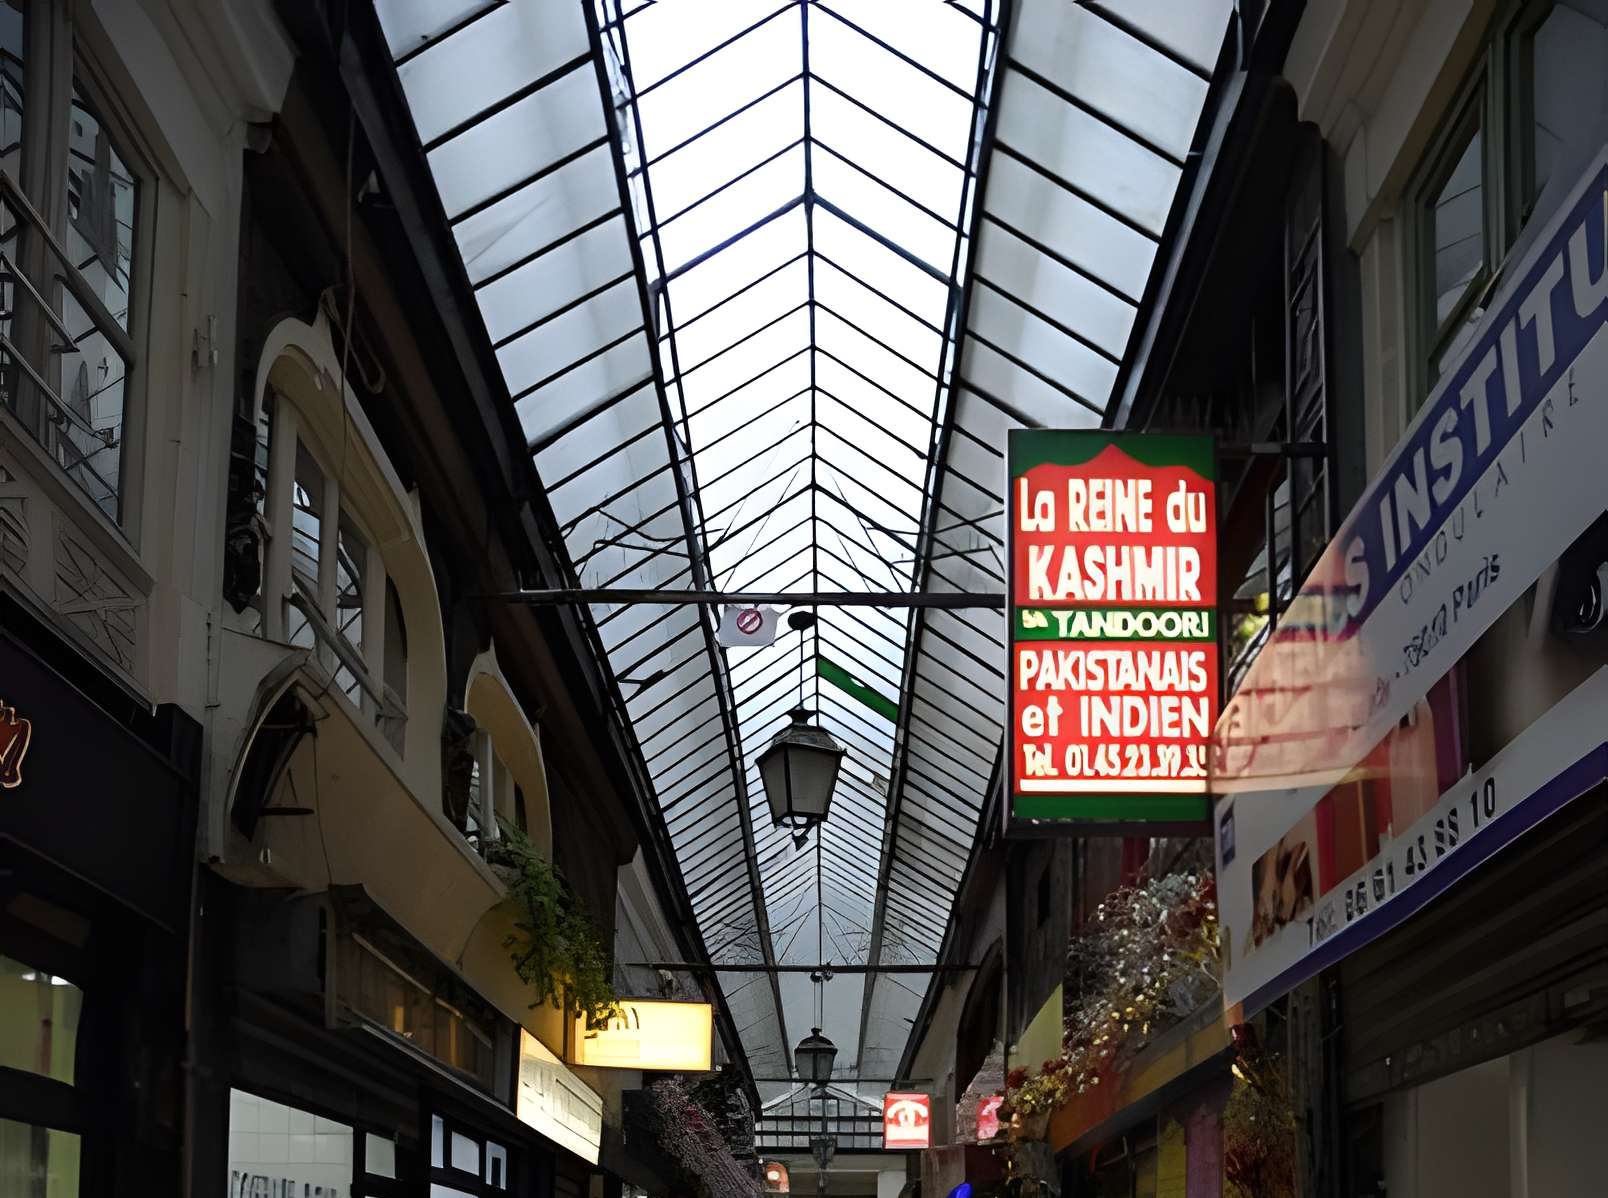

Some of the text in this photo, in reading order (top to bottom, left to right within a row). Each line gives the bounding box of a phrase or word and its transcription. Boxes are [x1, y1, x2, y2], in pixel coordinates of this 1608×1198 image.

[1068, 478, 1152, 533] REINE
[1166, 480, 1207, 533] du
[1028, 544, 1201, 601] KASHMIR
[1051, 610, 1209, 638] TANDOORI
[1020, 650, 1207, 692] PAKISTANAIS
[1021, 695, 1209, 738] et INDIEN
